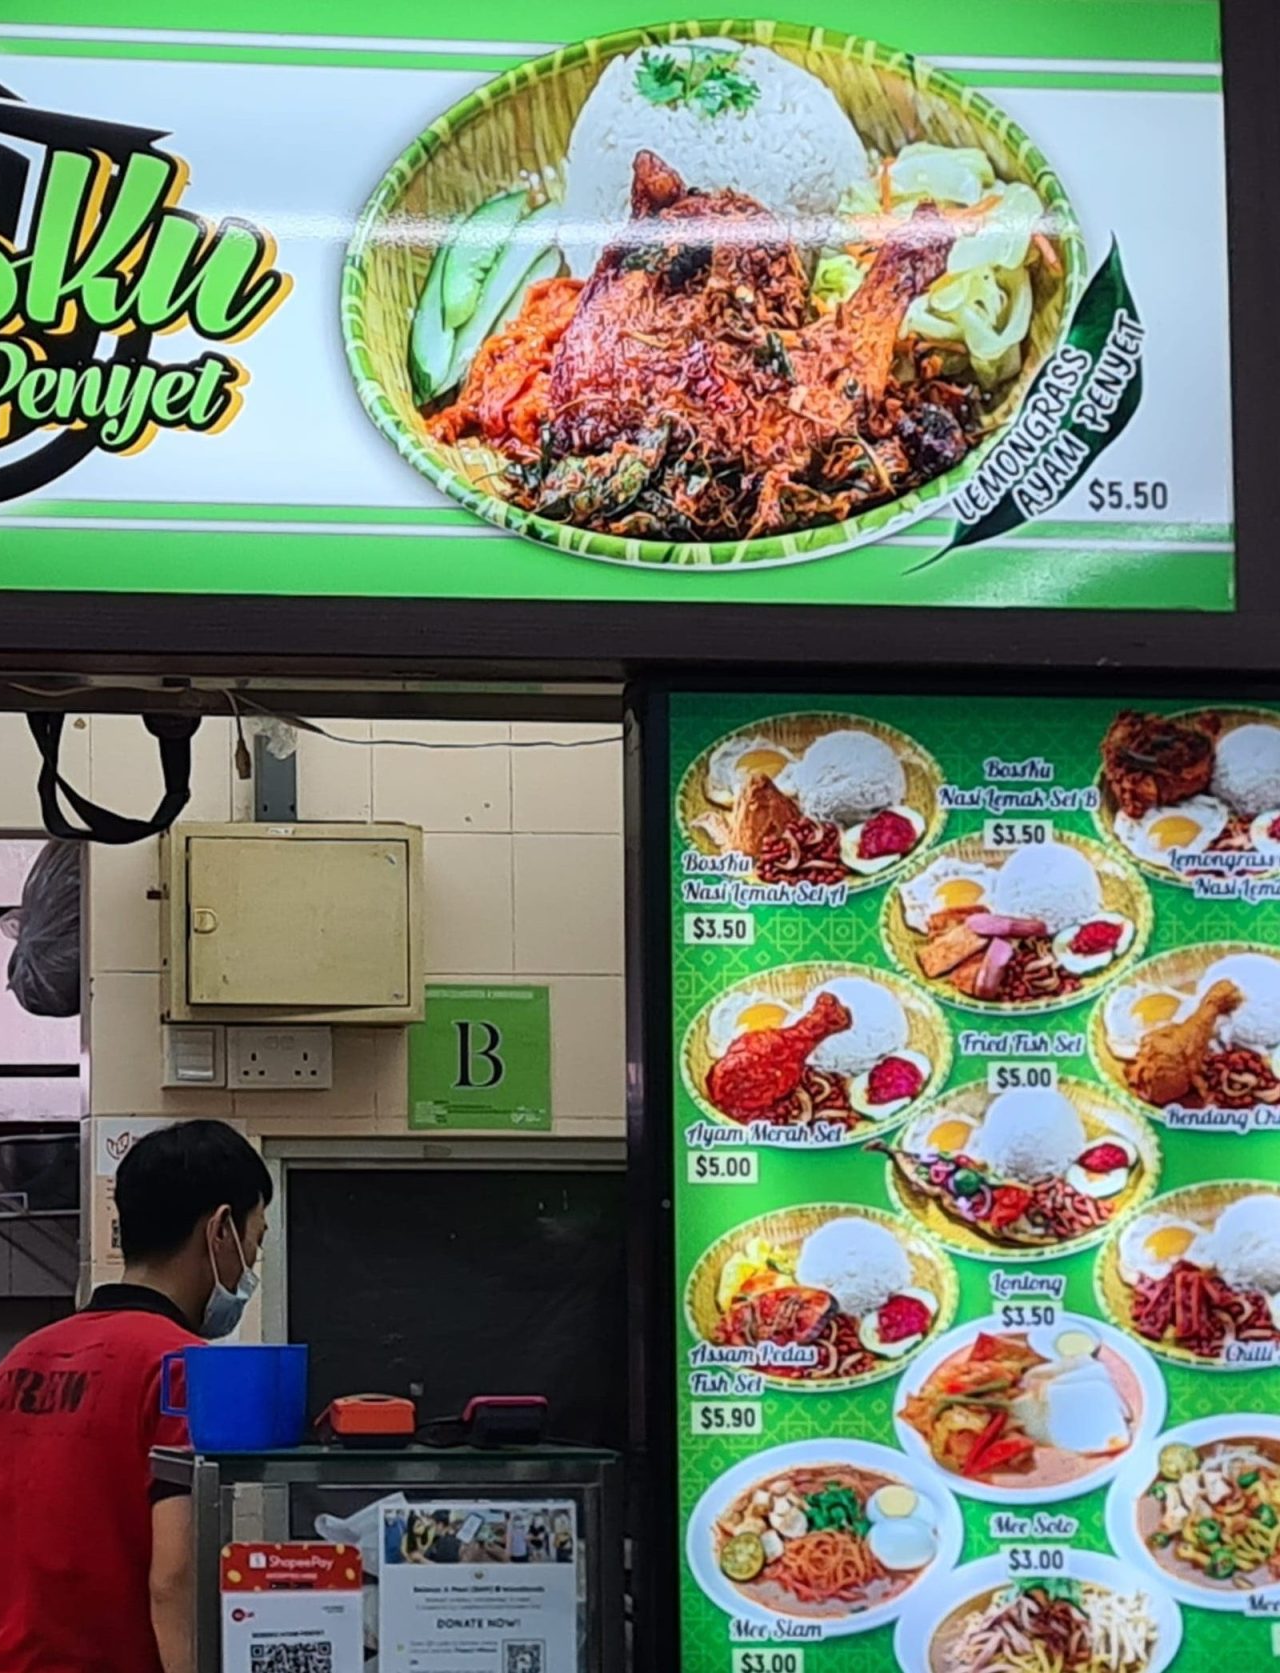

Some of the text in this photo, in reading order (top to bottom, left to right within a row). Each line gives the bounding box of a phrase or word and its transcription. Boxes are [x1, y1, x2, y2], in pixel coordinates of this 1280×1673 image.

[1015, 312, 1145, 517] AYAM PENYET
[954, 348, 1089, 521] LEMONGRASS
[1088, 478, 1168, 512] $5.50
[985, 758, 1052, 779] BossKu
[938, 787, 1099, 812] Nasi Lemak Set B
[992, 823, 1046, 845] $3.50
[683, 852, 751, 872] BossKu
[1167, 848, 1275, 873] Lemongrass
[683, 881, 846, 906] Nasi Lemak Set A
[1195, 878, 1237, 896] Nasi
[692, 916, 748, 940] $3.50
[961, 1032, 1083, 1053] Fried Fish Set
[451, 1020, 505, 1089] B
[995, 1066, 1052, 1089] $5.00
[1166, 1107, 1250, 1131] Rendang
[686, 1121, 843, 1147] Ayam Merah Set
[694, 1155, 752, 1179] $5.00
[991, 1271, 1064, 1297] Lontong
[1001, 1305, 1055, 1328] $3.50
[691, 1342, 816, 1364] Assam Pedas
[691, 1373, 763, 1394] Fish Set
[699, 1406, 756, 1430] $5.90
[993, 1514, 1075, 1534] Mee Soto
[268, 1554, 335, 1572] ShopeePay
[1008, 1548, 1064, 1571] $3.00
[436, 1618, 484, 1630] DONATE
[732, 1618, 823, 1638] Mee Siam
[740, 1652, 797, 1673] $3.00
